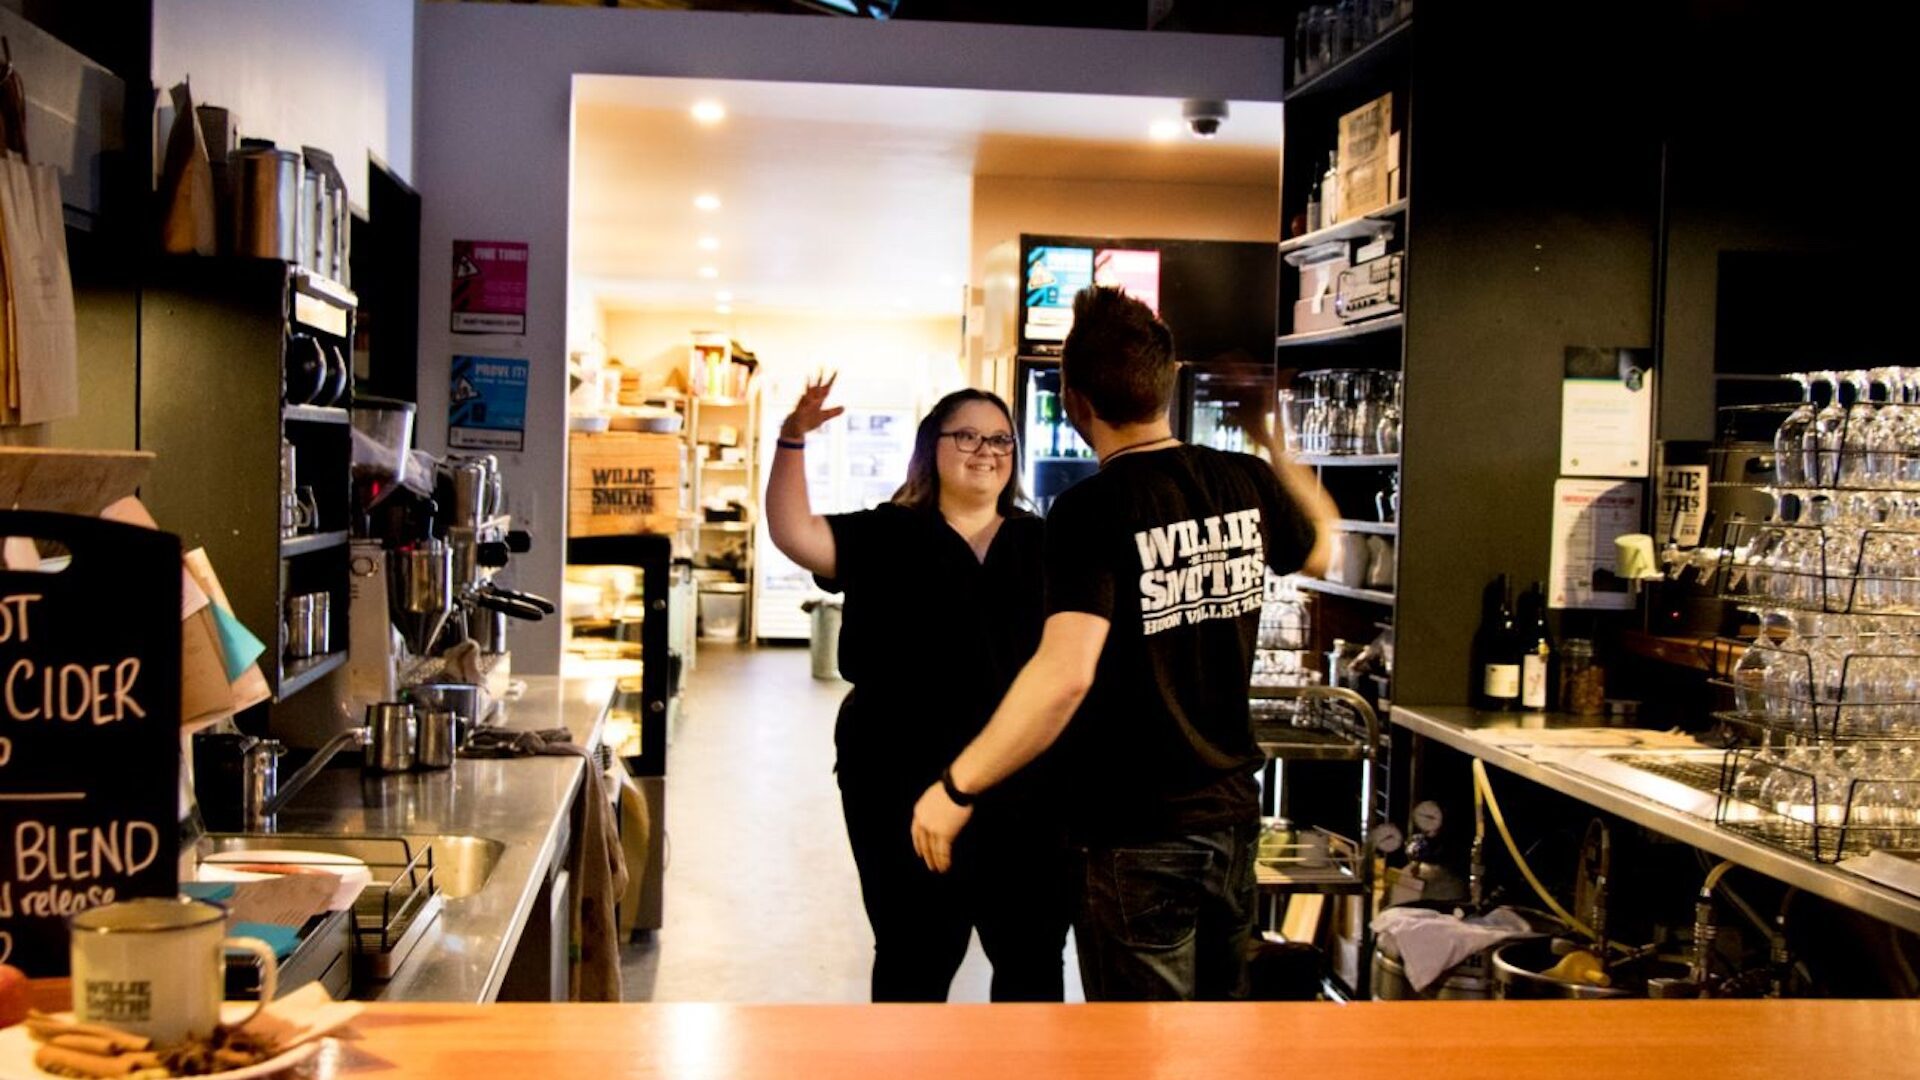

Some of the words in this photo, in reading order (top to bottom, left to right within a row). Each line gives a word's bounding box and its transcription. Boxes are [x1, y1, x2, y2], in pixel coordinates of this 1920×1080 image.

[592, 468, 655, 486] WILLIE
[1134, 508, 1263, 571] WILLIE
[5, 656, 147, 726] CIDER
[15, 820, 160, 882] BLEND
[21, 883, 116, 917] release
